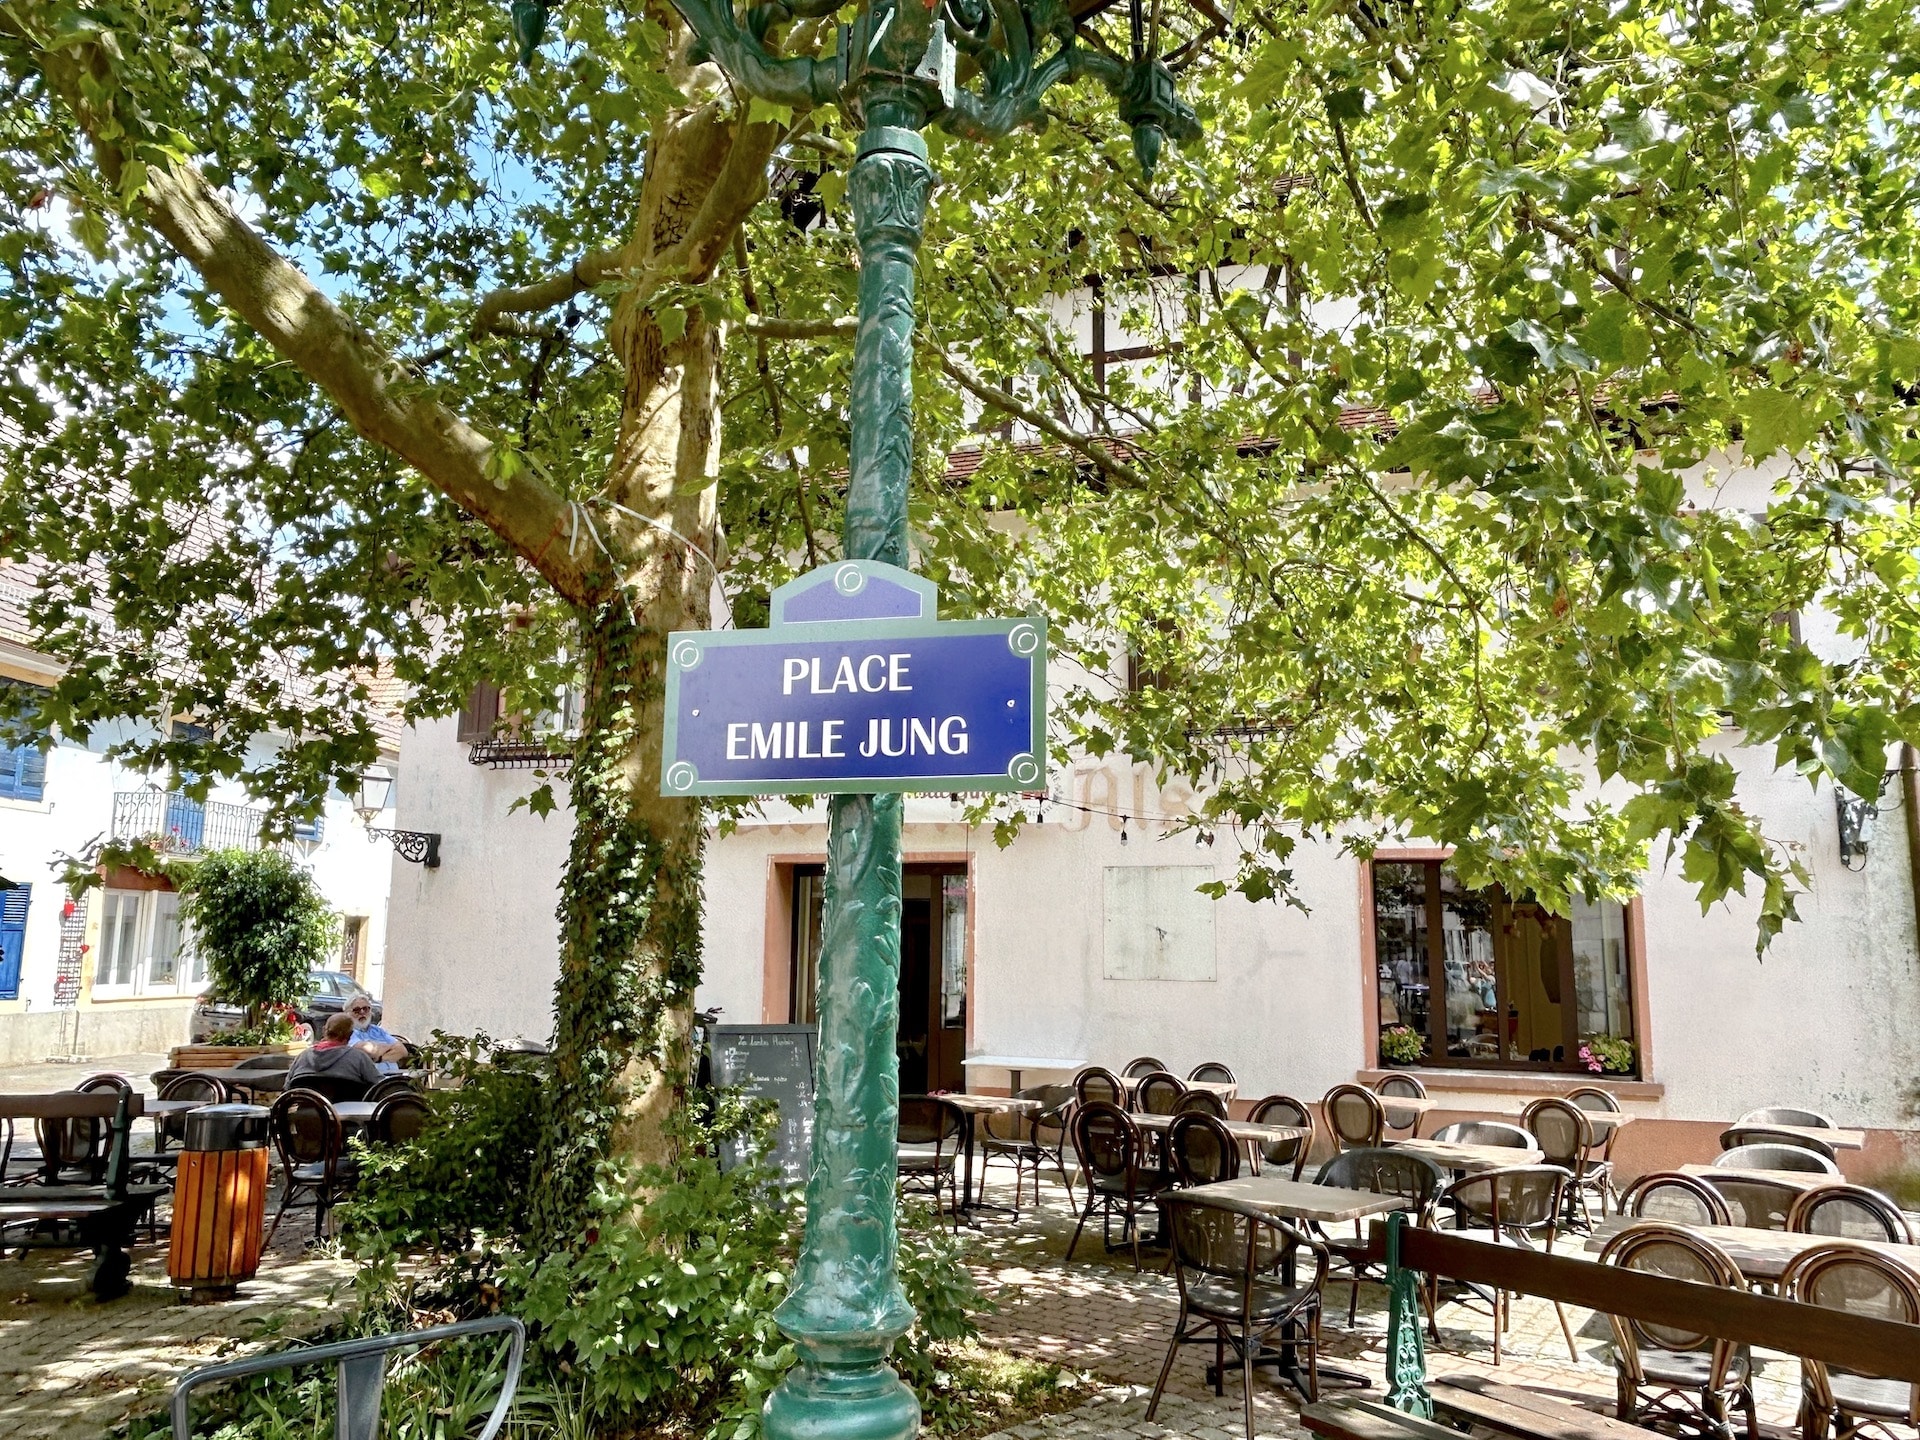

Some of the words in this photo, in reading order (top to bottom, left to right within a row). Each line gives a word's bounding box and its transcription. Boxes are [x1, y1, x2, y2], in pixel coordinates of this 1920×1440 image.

[783, 654, 912, 695] PLACE
[727, 721, 845, 759] EMILE
[860, 716, 967, 756] JUNG
